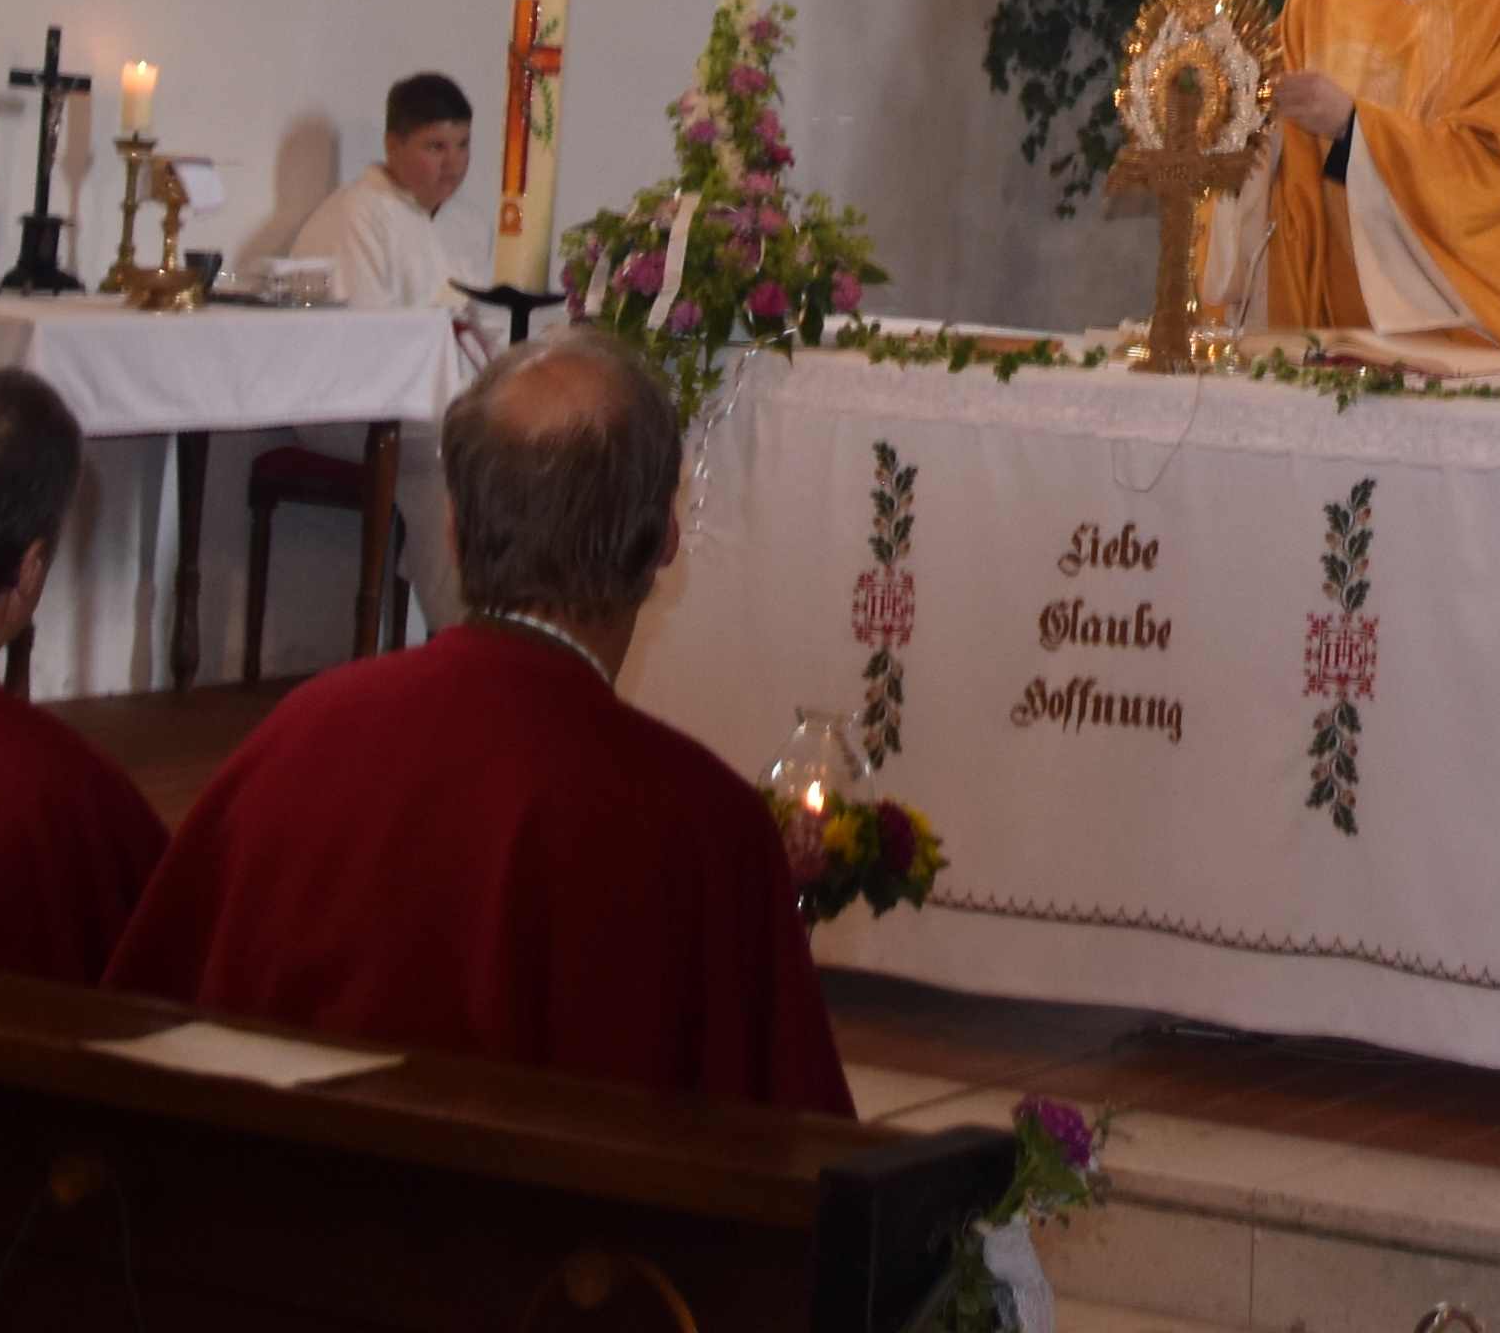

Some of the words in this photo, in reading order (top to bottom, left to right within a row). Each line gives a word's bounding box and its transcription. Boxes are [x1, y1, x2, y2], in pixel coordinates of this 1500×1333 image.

[1057, 521, 1159, 577] Liebe
[1038, 598, 1171, 652] Glaube
[1010, 676, 1184, 745] Hoffnung
